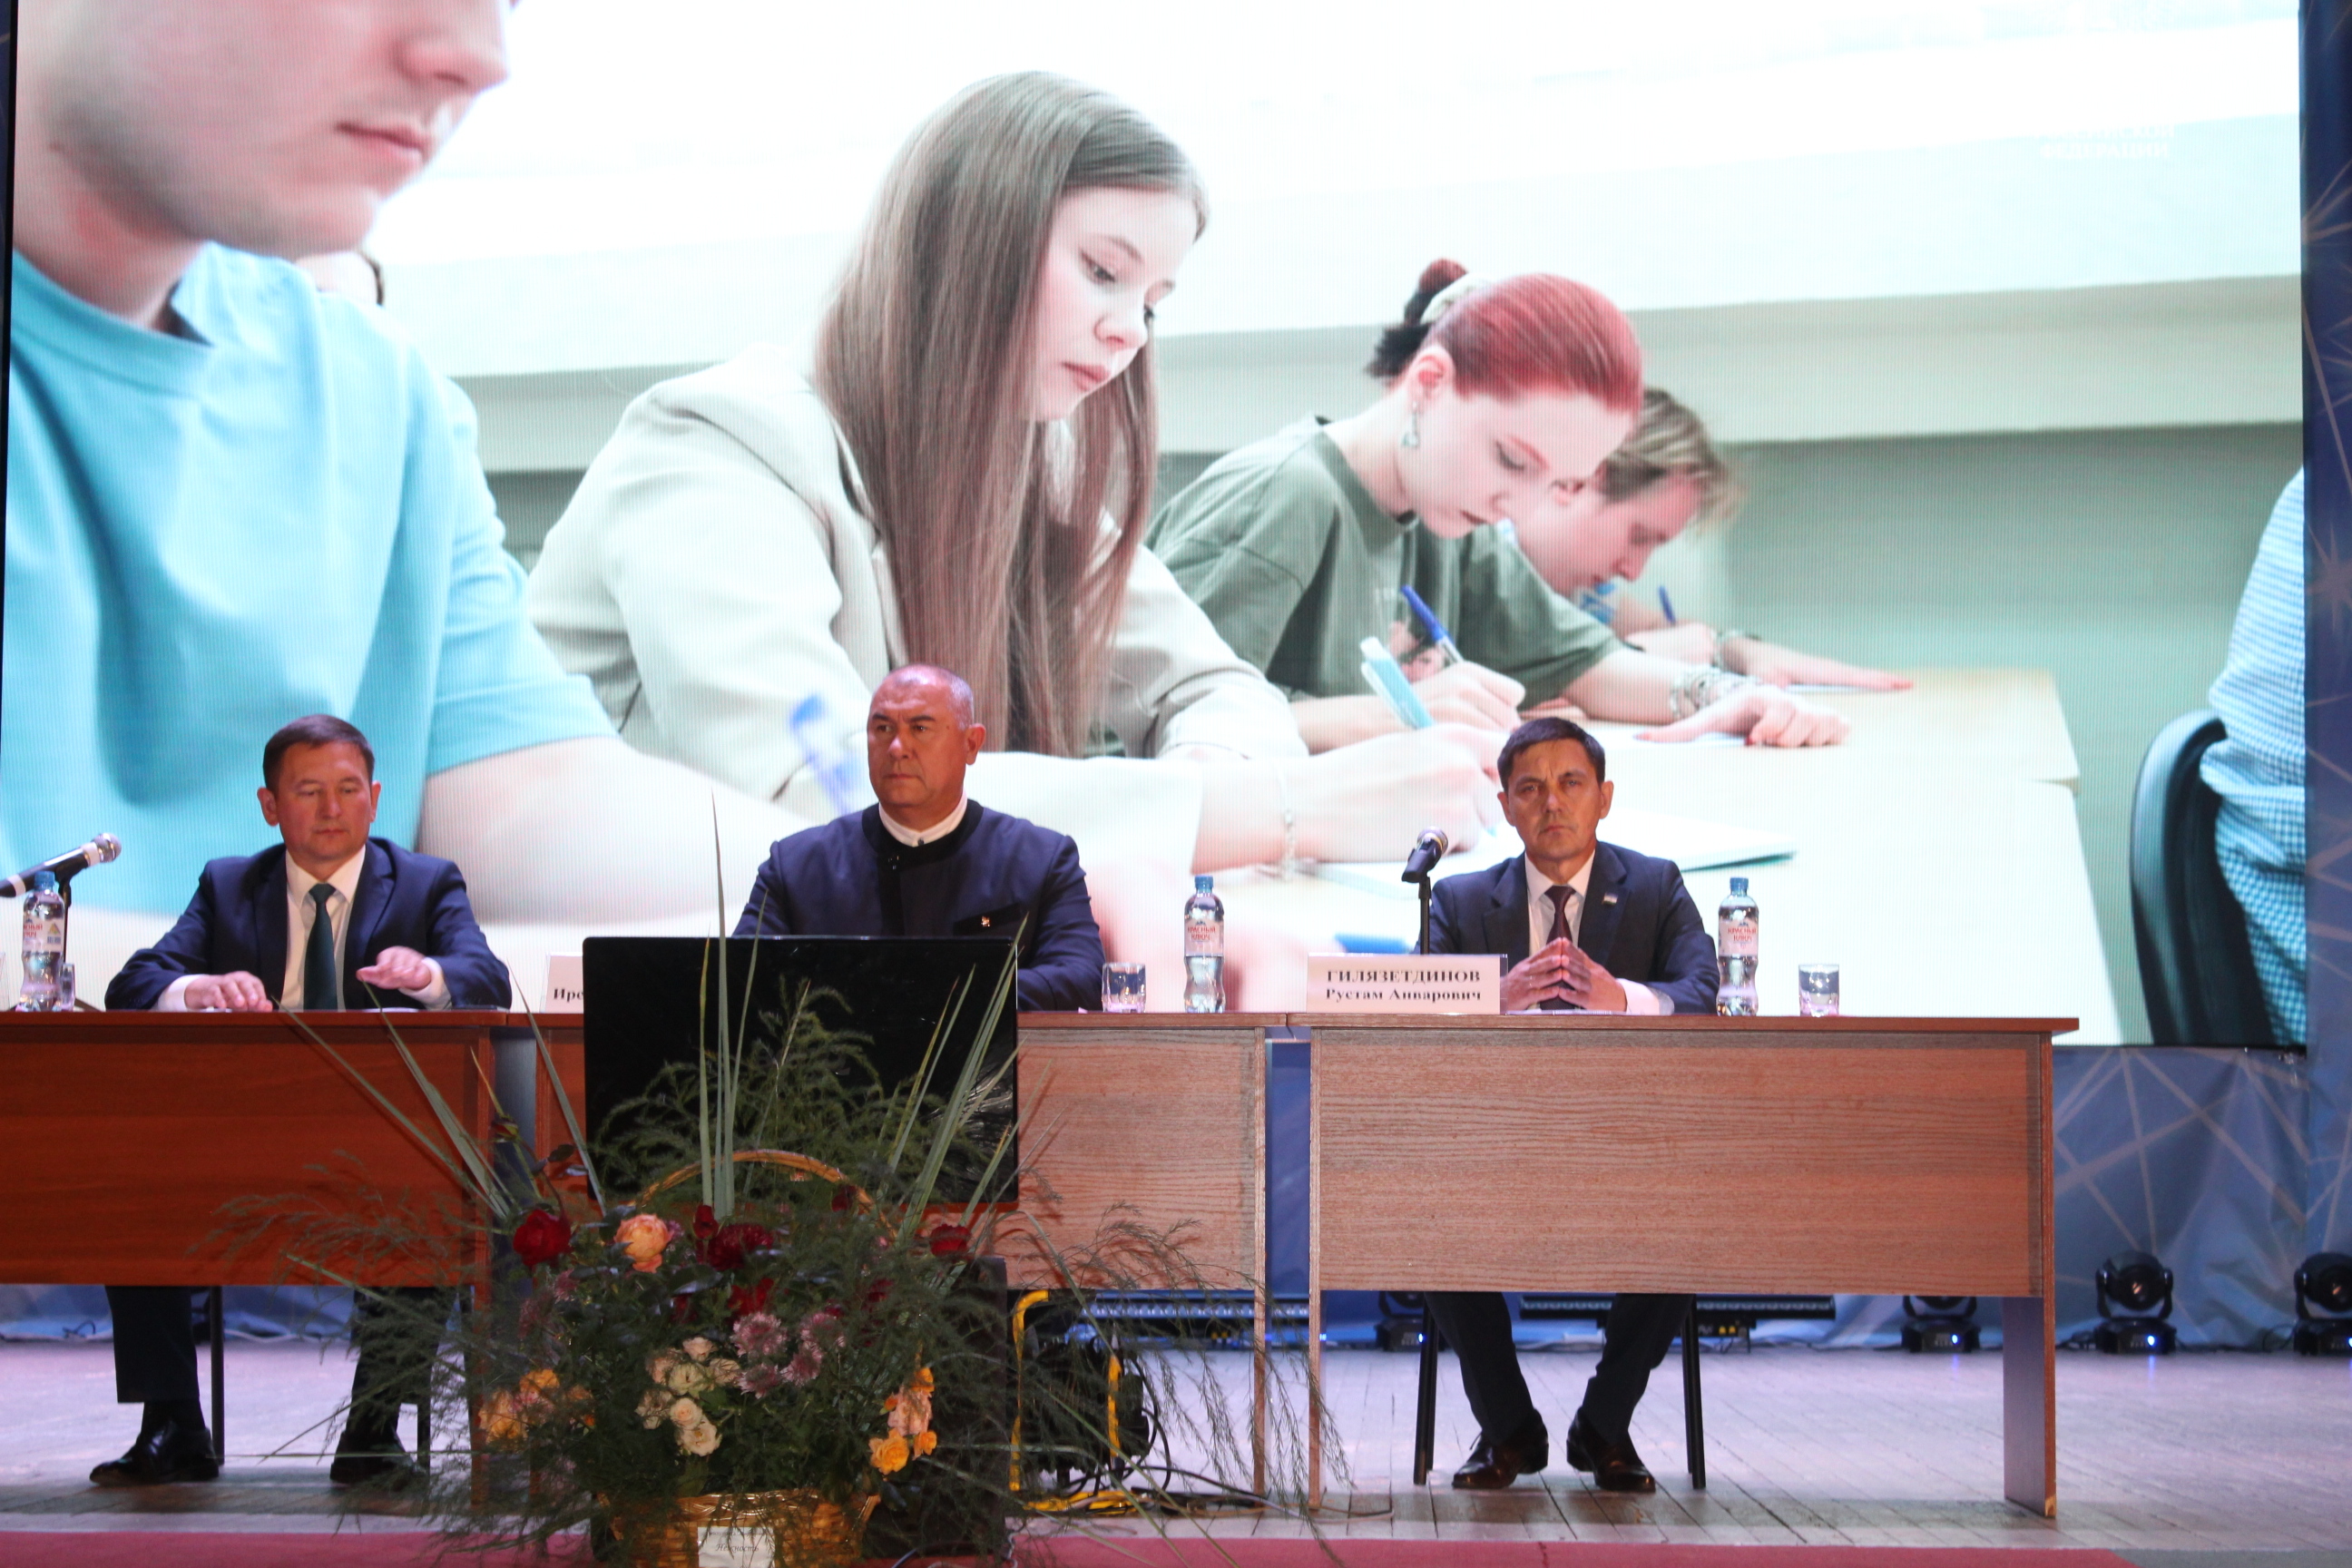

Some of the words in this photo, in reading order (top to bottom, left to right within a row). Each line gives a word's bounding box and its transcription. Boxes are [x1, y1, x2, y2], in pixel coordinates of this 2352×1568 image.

[1327, 970, 1481, 985] ГИЛЯЗЕТДИНОВ
[1326, 988, 1383, 1003] Рустам
[1389, 988, 1481, 1003] Анварович
